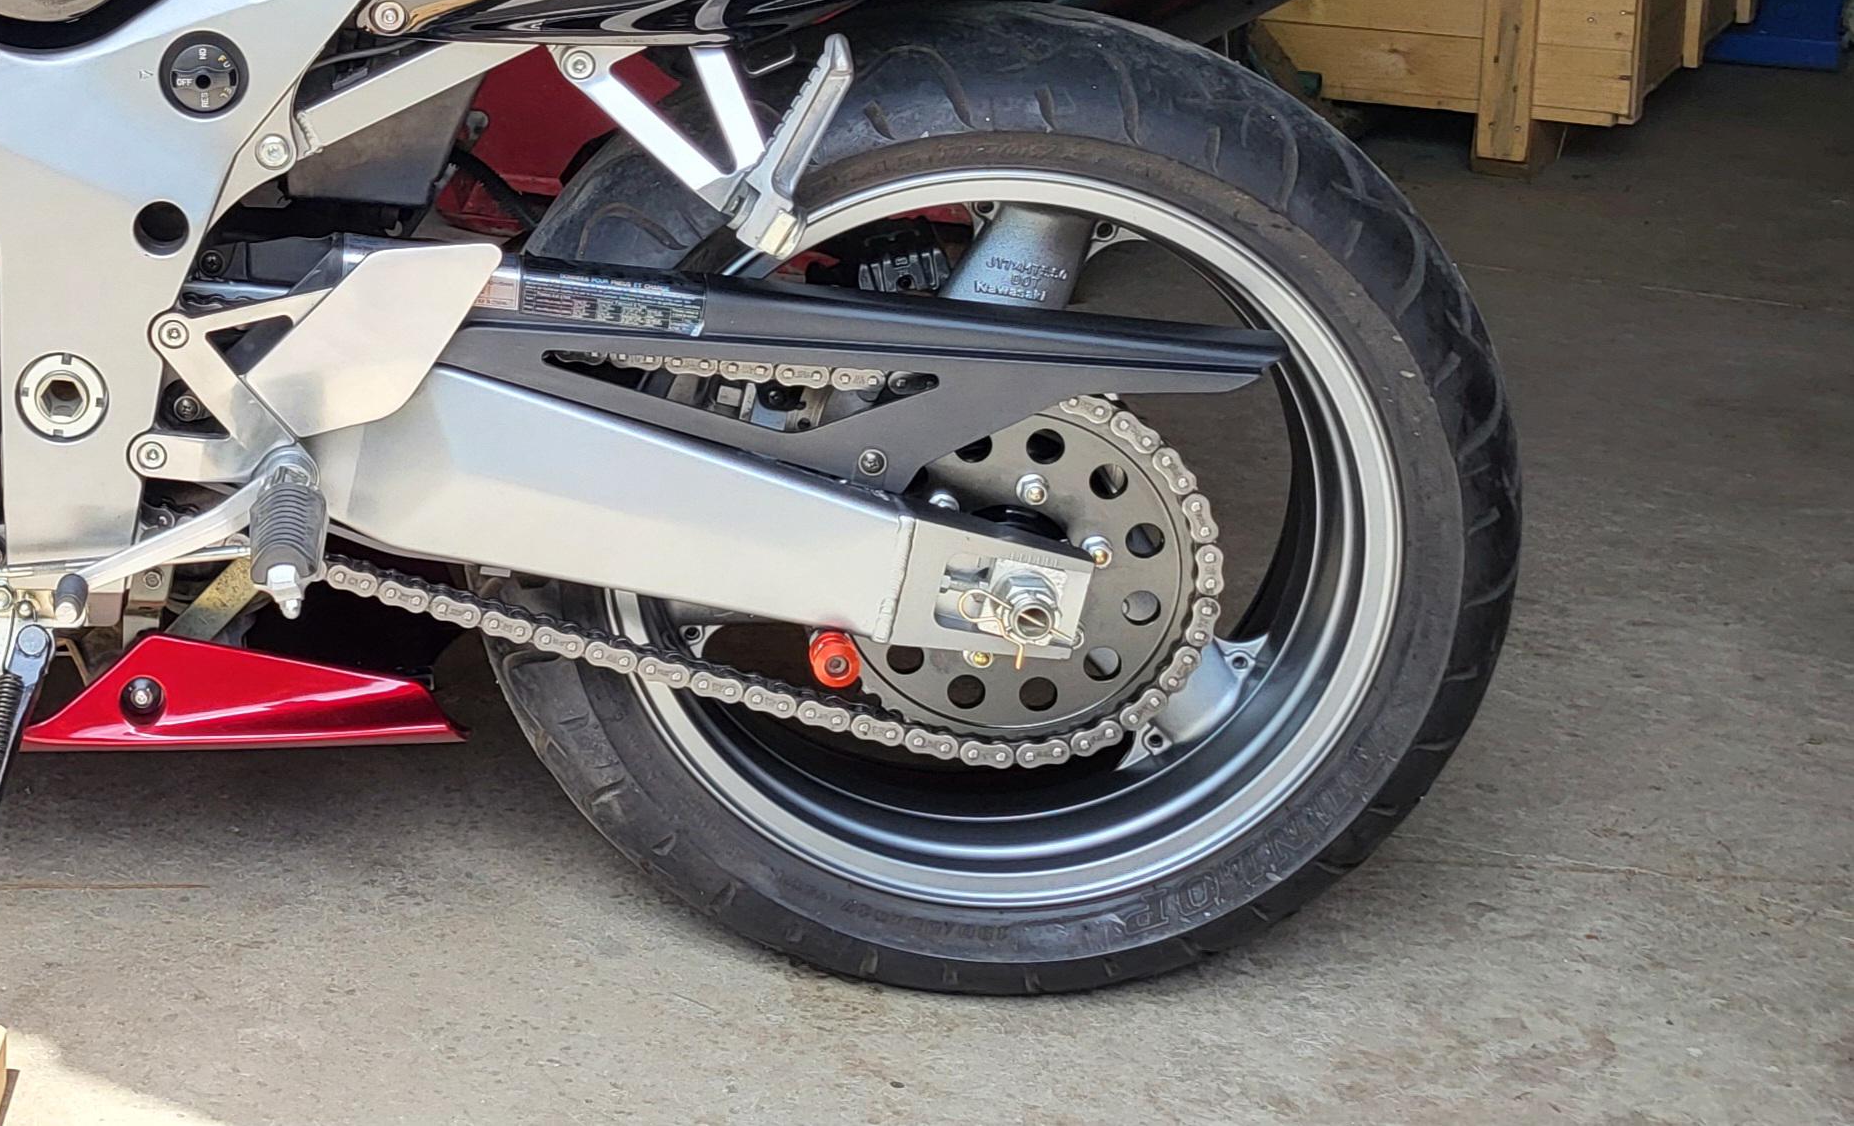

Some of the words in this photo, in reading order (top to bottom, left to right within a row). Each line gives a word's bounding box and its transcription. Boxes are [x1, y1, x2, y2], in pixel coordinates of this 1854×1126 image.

[198, 48, 207, 60] ON
[176, 78, 193, 86] OFF
[201, 92, 210, 108] RES
[1011, 274, 1041, 289] DOT
[974, 280, 1047, 302] Kawasaki
